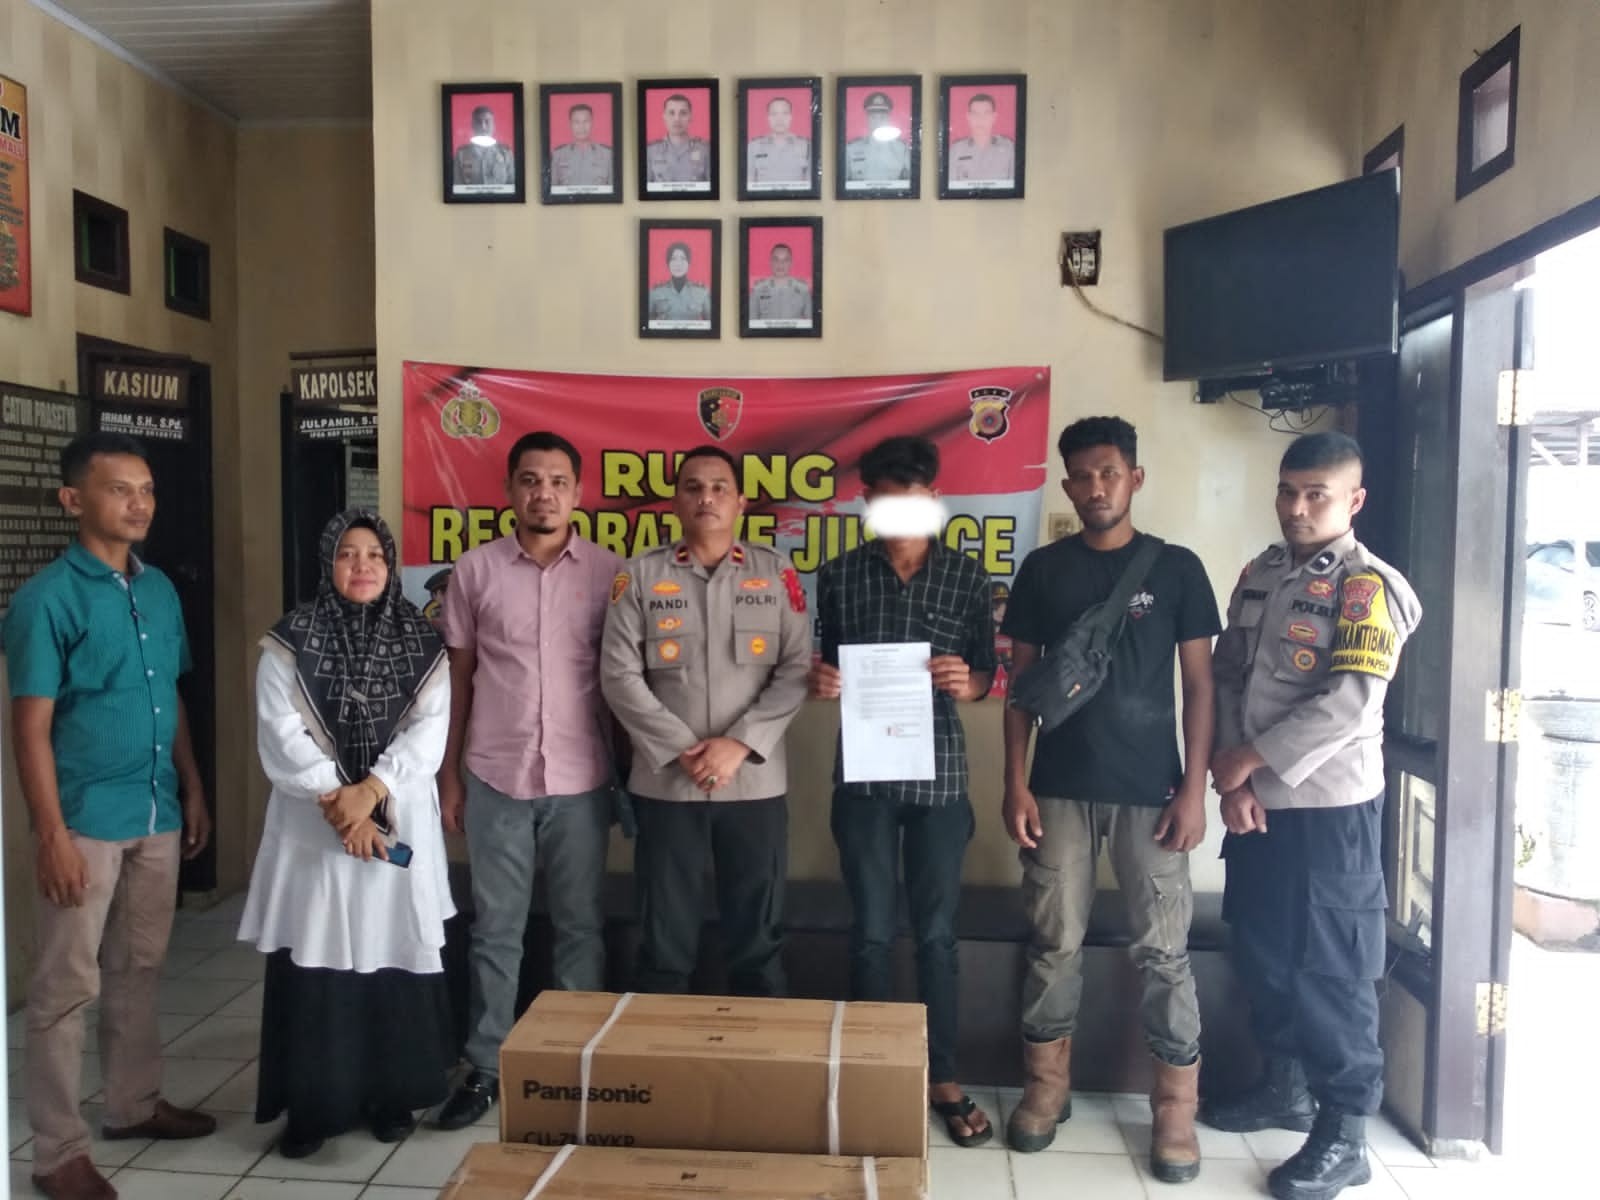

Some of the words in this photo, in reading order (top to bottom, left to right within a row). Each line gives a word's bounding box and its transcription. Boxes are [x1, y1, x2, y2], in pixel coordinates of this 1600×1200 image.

[104, 370, 179, 400] KASIUM
[300, 370, 375, 400] KAPOLSEK
[602, 450, 837, 502] RUNG
[791, 514, 1016, 574] JUCE
[650, 599, 688, 611] PANDI
[736, 594, 777, 605] POLRI
[523, 1080, 651, 1104] Panasonic
